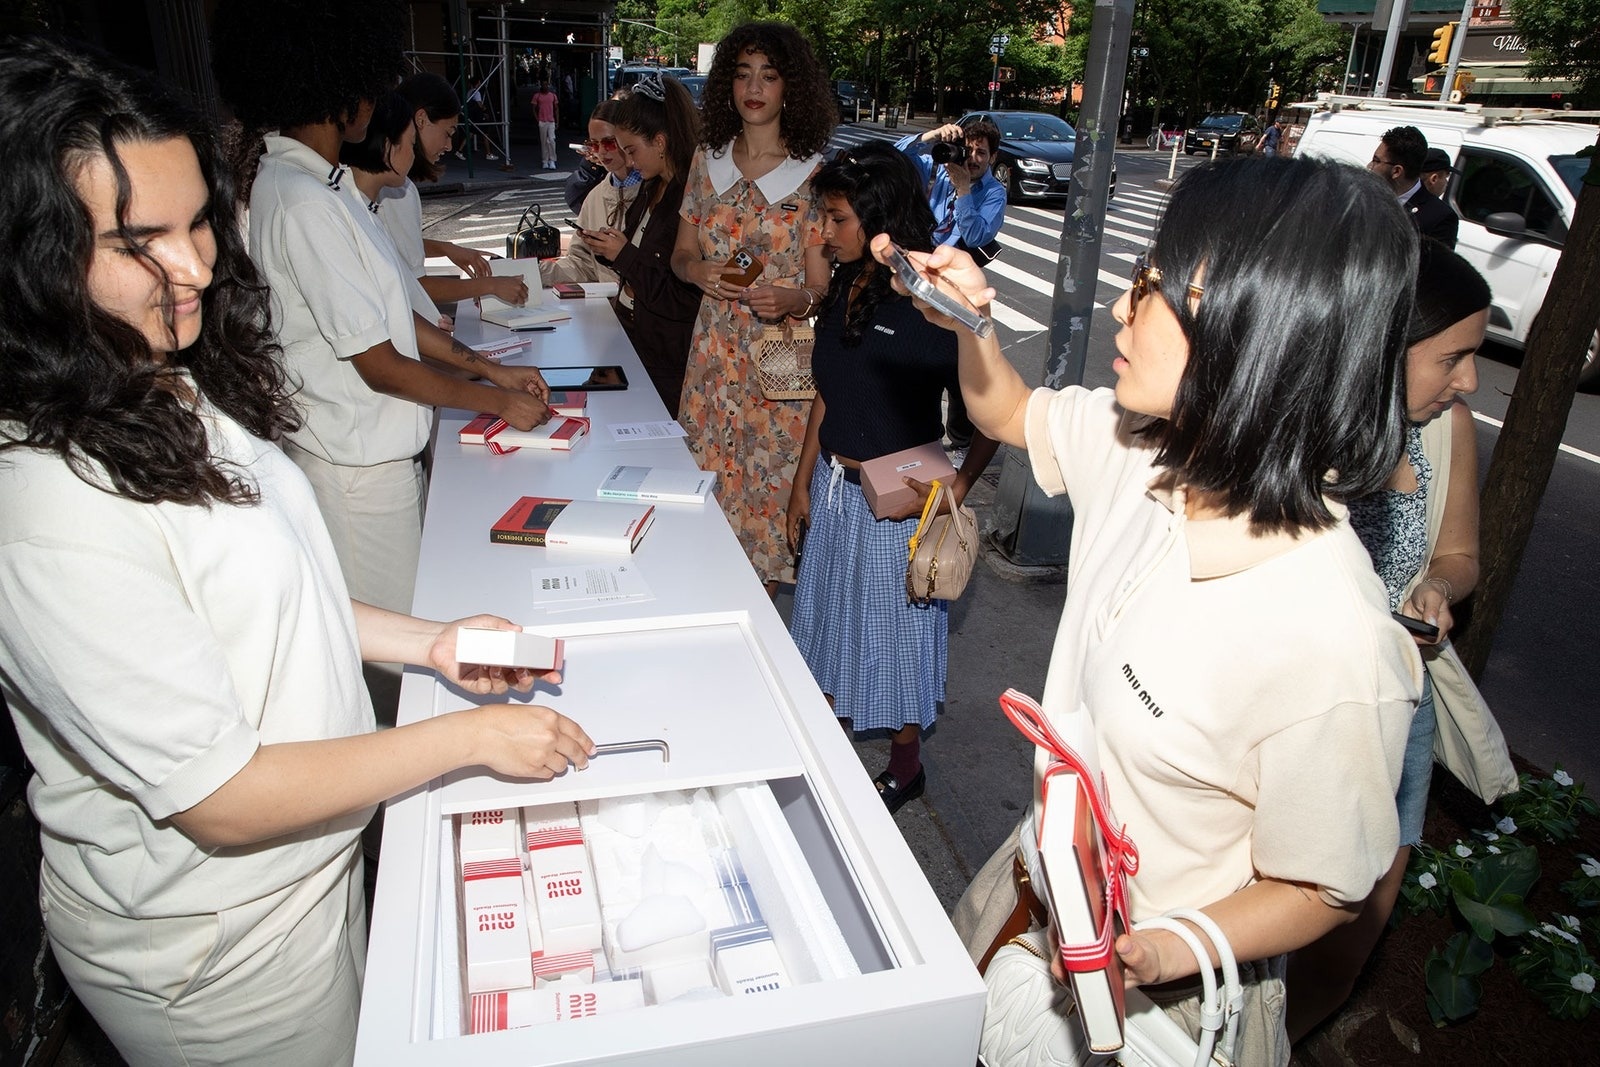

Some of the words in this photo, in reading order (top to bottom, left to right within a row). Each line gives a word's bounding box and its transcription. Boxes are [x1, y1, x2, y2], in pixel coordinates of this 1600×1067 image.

[1493, 35, 1528, 54] Villag
[1122, 663, 1141, 691] miu
[1138, 690, 1164, 718] miu
[546, 878, 581, 890] miu
[548, 887, 582, 899] miu
[478, 911, 514, 922] miu
[479, 920, 515, 932] miu
